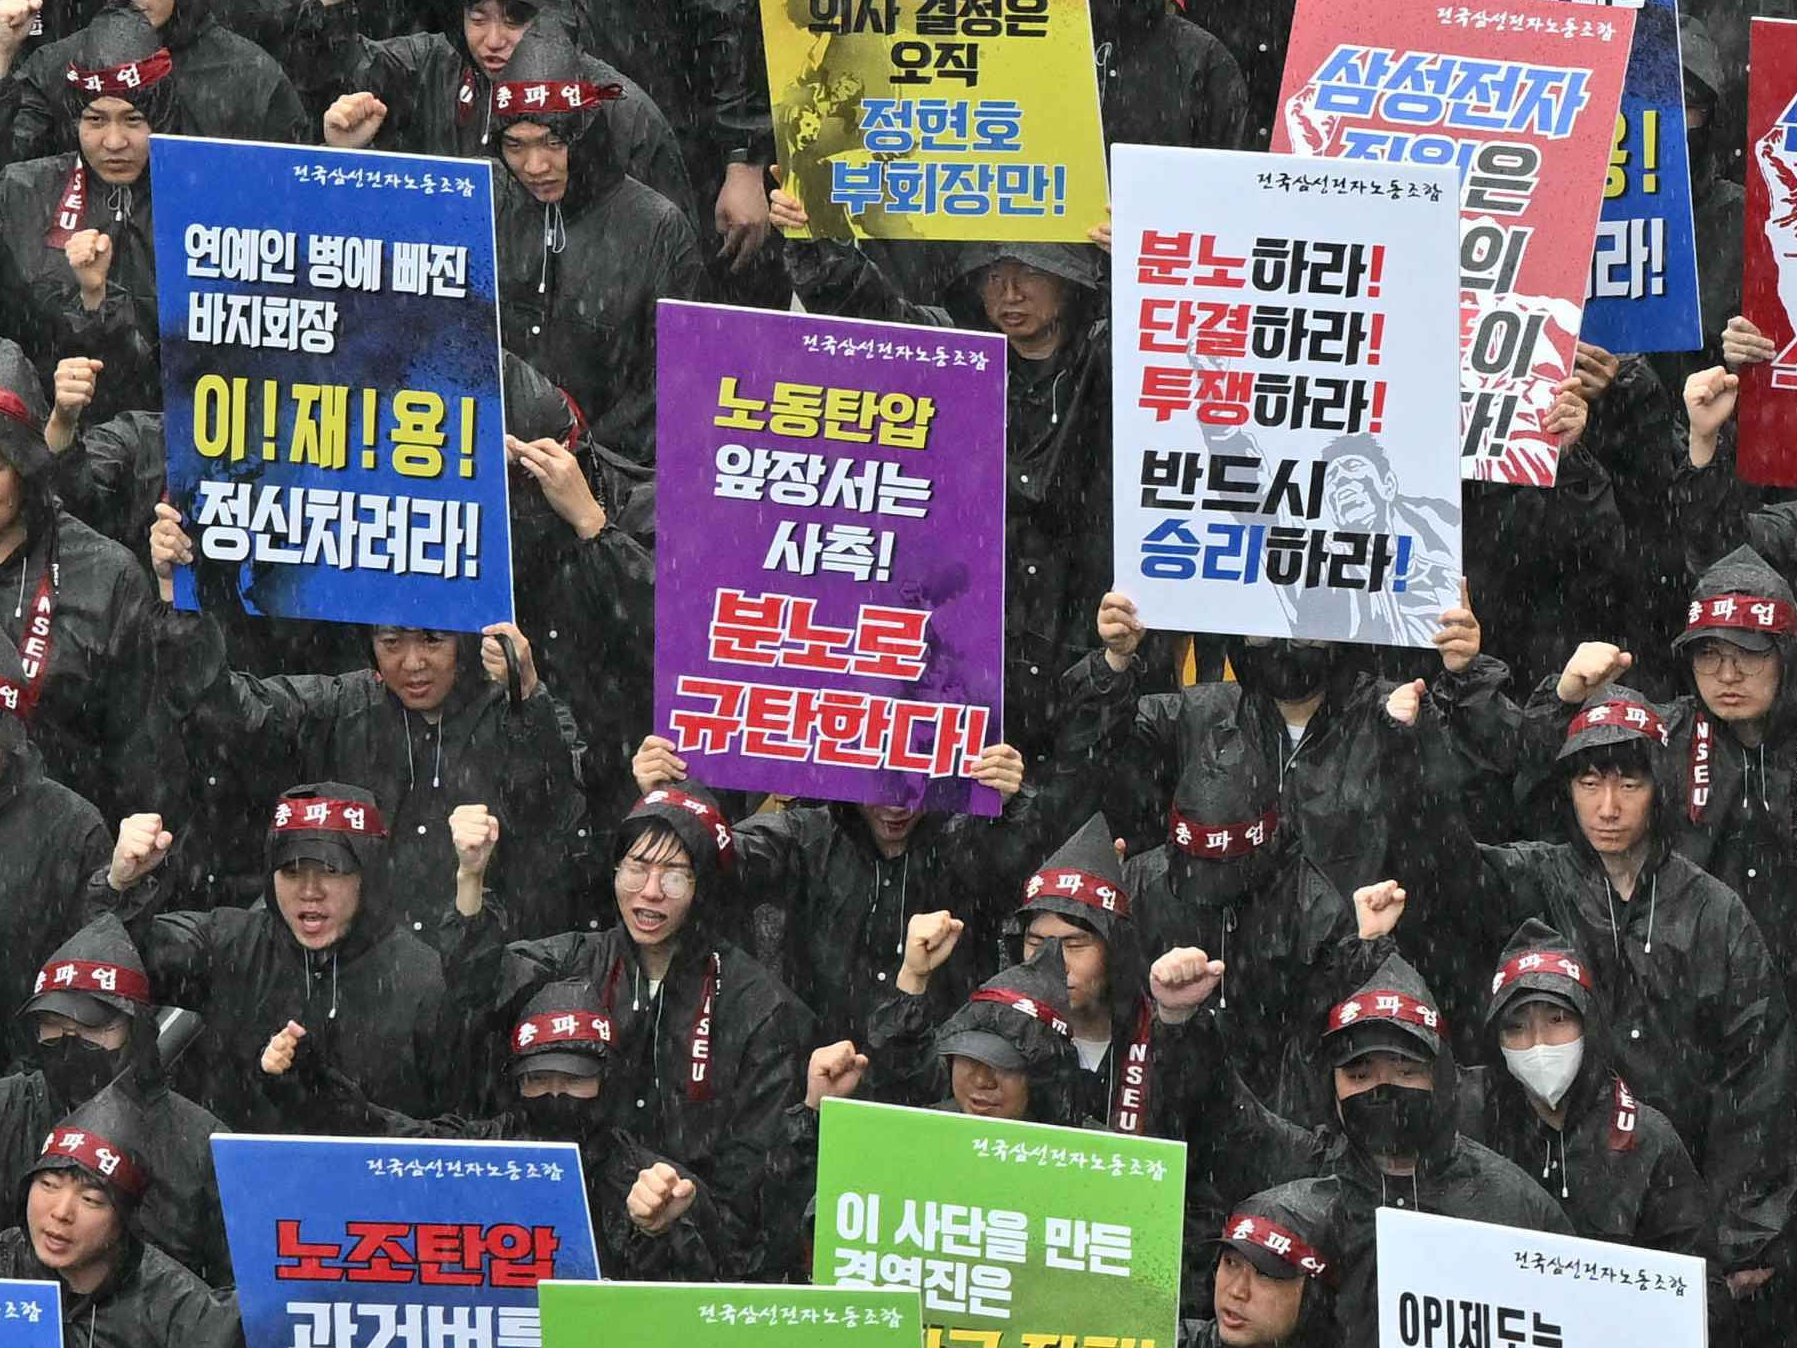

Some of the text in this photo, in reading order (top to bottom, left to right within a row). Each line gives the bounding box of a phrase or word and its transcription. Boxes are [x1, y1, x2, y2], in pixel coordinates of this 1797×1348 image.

[890, 42, 979, 87] 오직
[1313, 44, 1594, 141] 삼성전자
[860, 98, 1023, 152] 정현호
[831, 162, 1065, 215] 부회장만!
[1138, 230, 1386, 298] 분노하라!
[1139, 298, 1386, 366] 단결하라!
[1139, 366, 1387, 434] 투쟁하라!
[1141, 451, 1327, 520] 반드시
[1141, 518, 1412, 593] 승리하라!
[276, 1219, 559, 1287] 노조탄압
[836, 1193, 1132, 1276] 이 사단을 만든
